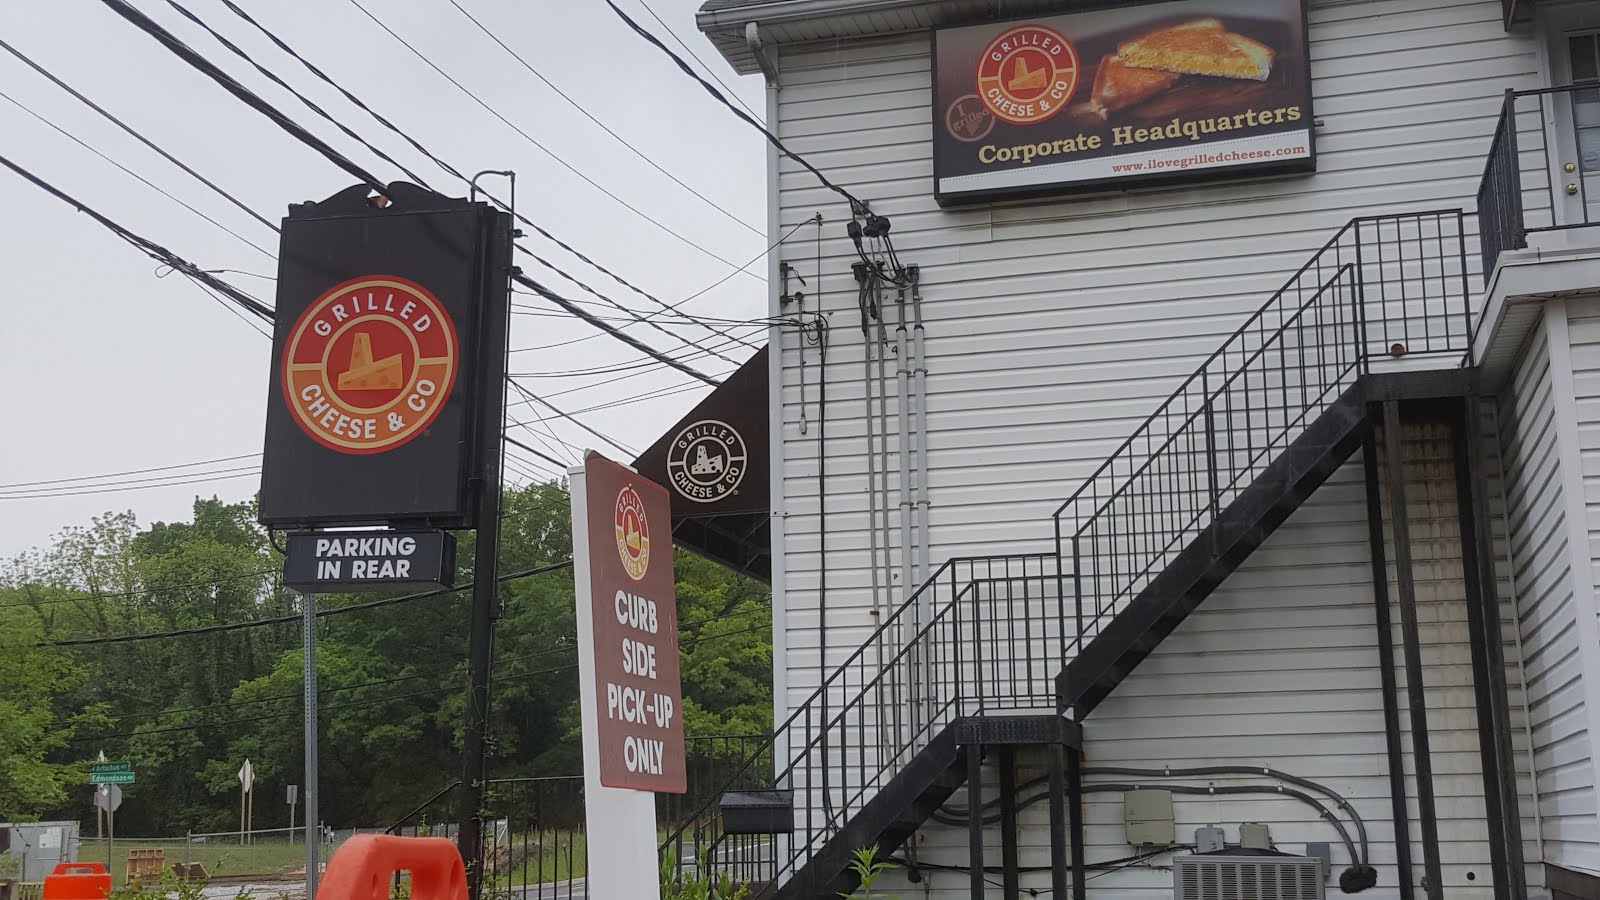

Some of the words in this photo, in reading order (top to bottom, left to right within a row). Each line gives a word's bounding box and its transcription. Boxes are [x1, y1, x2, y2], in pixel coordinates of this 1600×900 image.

[991, 34, 1061, 61] GRILLED
[987, 88, 1035, 117] CHEESE
[1039, 100, 1050, 111] &
[1051, 80, 1068, 100] CO
[978, 133, 1102, 164] Corporate
[1112, 106, 1301, 146] Headquarters
[1112, 146, 1306, 173] www.ilovegrilledcheese.com
[314, 292, 431, 337] GRILLED
[301, 384, 376, 439] CHEESE
[388, 412, 405, 432] &
[408, 378, 436, 412] CO
[678, 426, 735, 449] GRILLED
[674, 471, 713, 498] CHEESE
[716, 483, 726, 494] &
[725, 467, 739, 484] CO
[619, 493, 644, 522] GRILLED
[315, 536, 417, 558] PARKING
[317, 560, 341, 580] IN
[351, 559, 411, 579] REAR
[614, 589, 658, 634] CURB
[622, 638, 657, 680] SIDE
[607, 682, 674, 729] PICK-UP
[623, 735, 664, 775] ONLY
[91, 774, 127, 782] Edmondson
